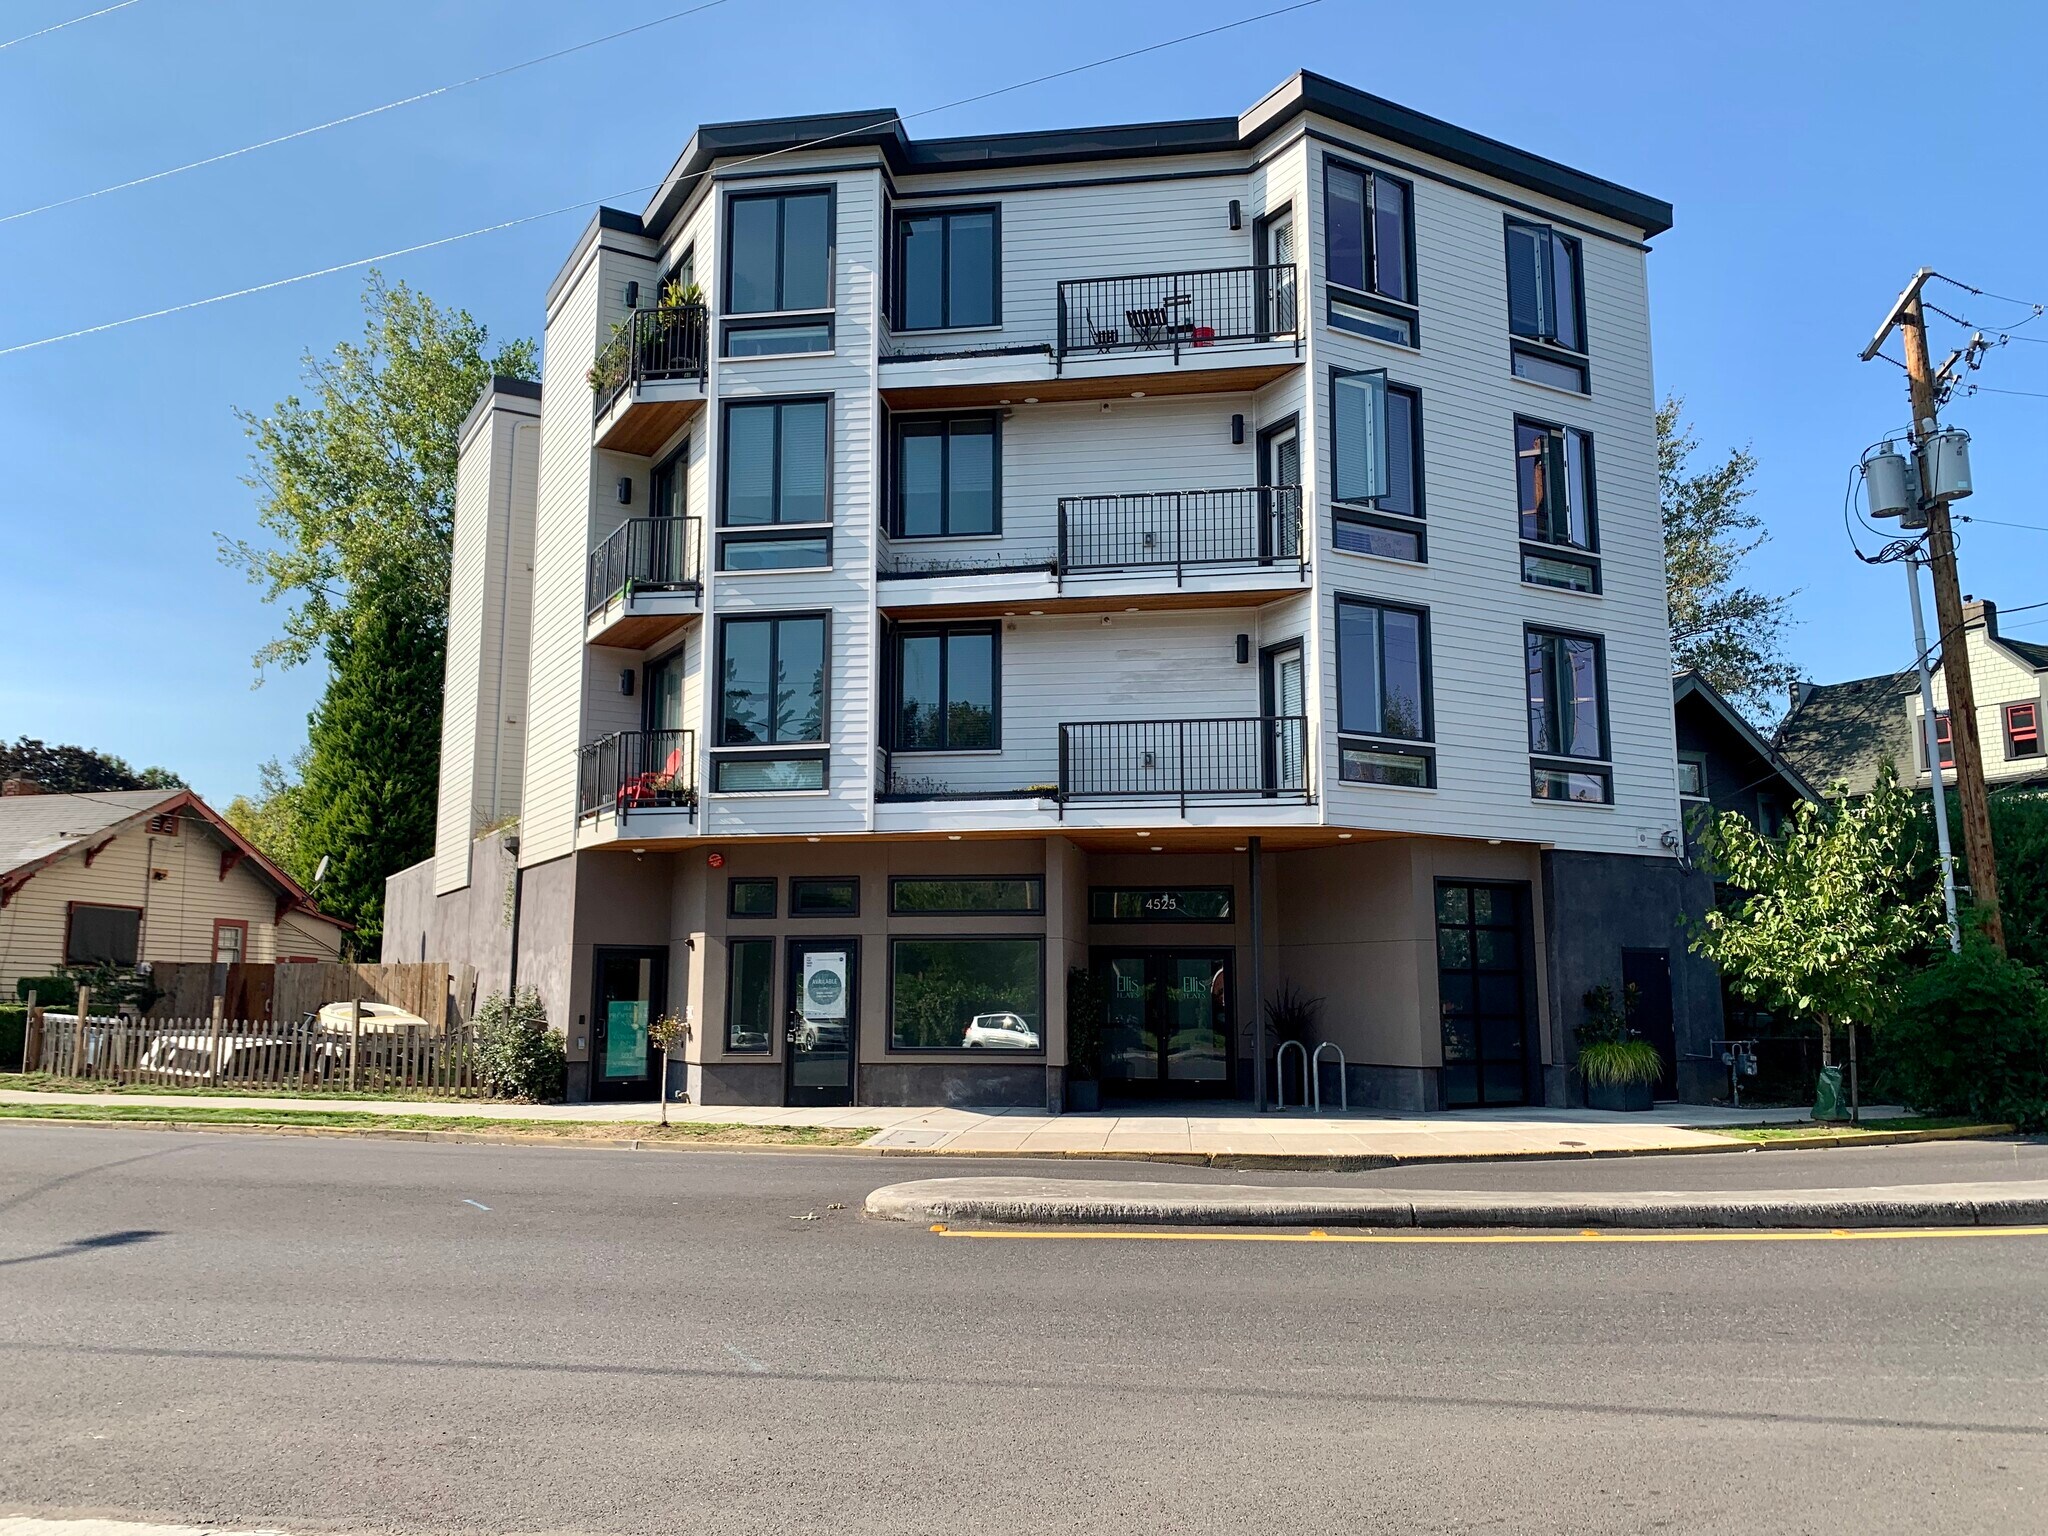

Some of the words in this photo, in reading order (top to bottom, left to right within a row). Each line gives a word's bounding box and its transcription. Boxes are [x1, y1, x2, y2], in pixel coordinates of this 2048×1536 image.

[1145, 898, 1177, 910] 4525
[1117, 976, 1139, 992] Ellis
[1183, 976, 1207, 993] Ellis
